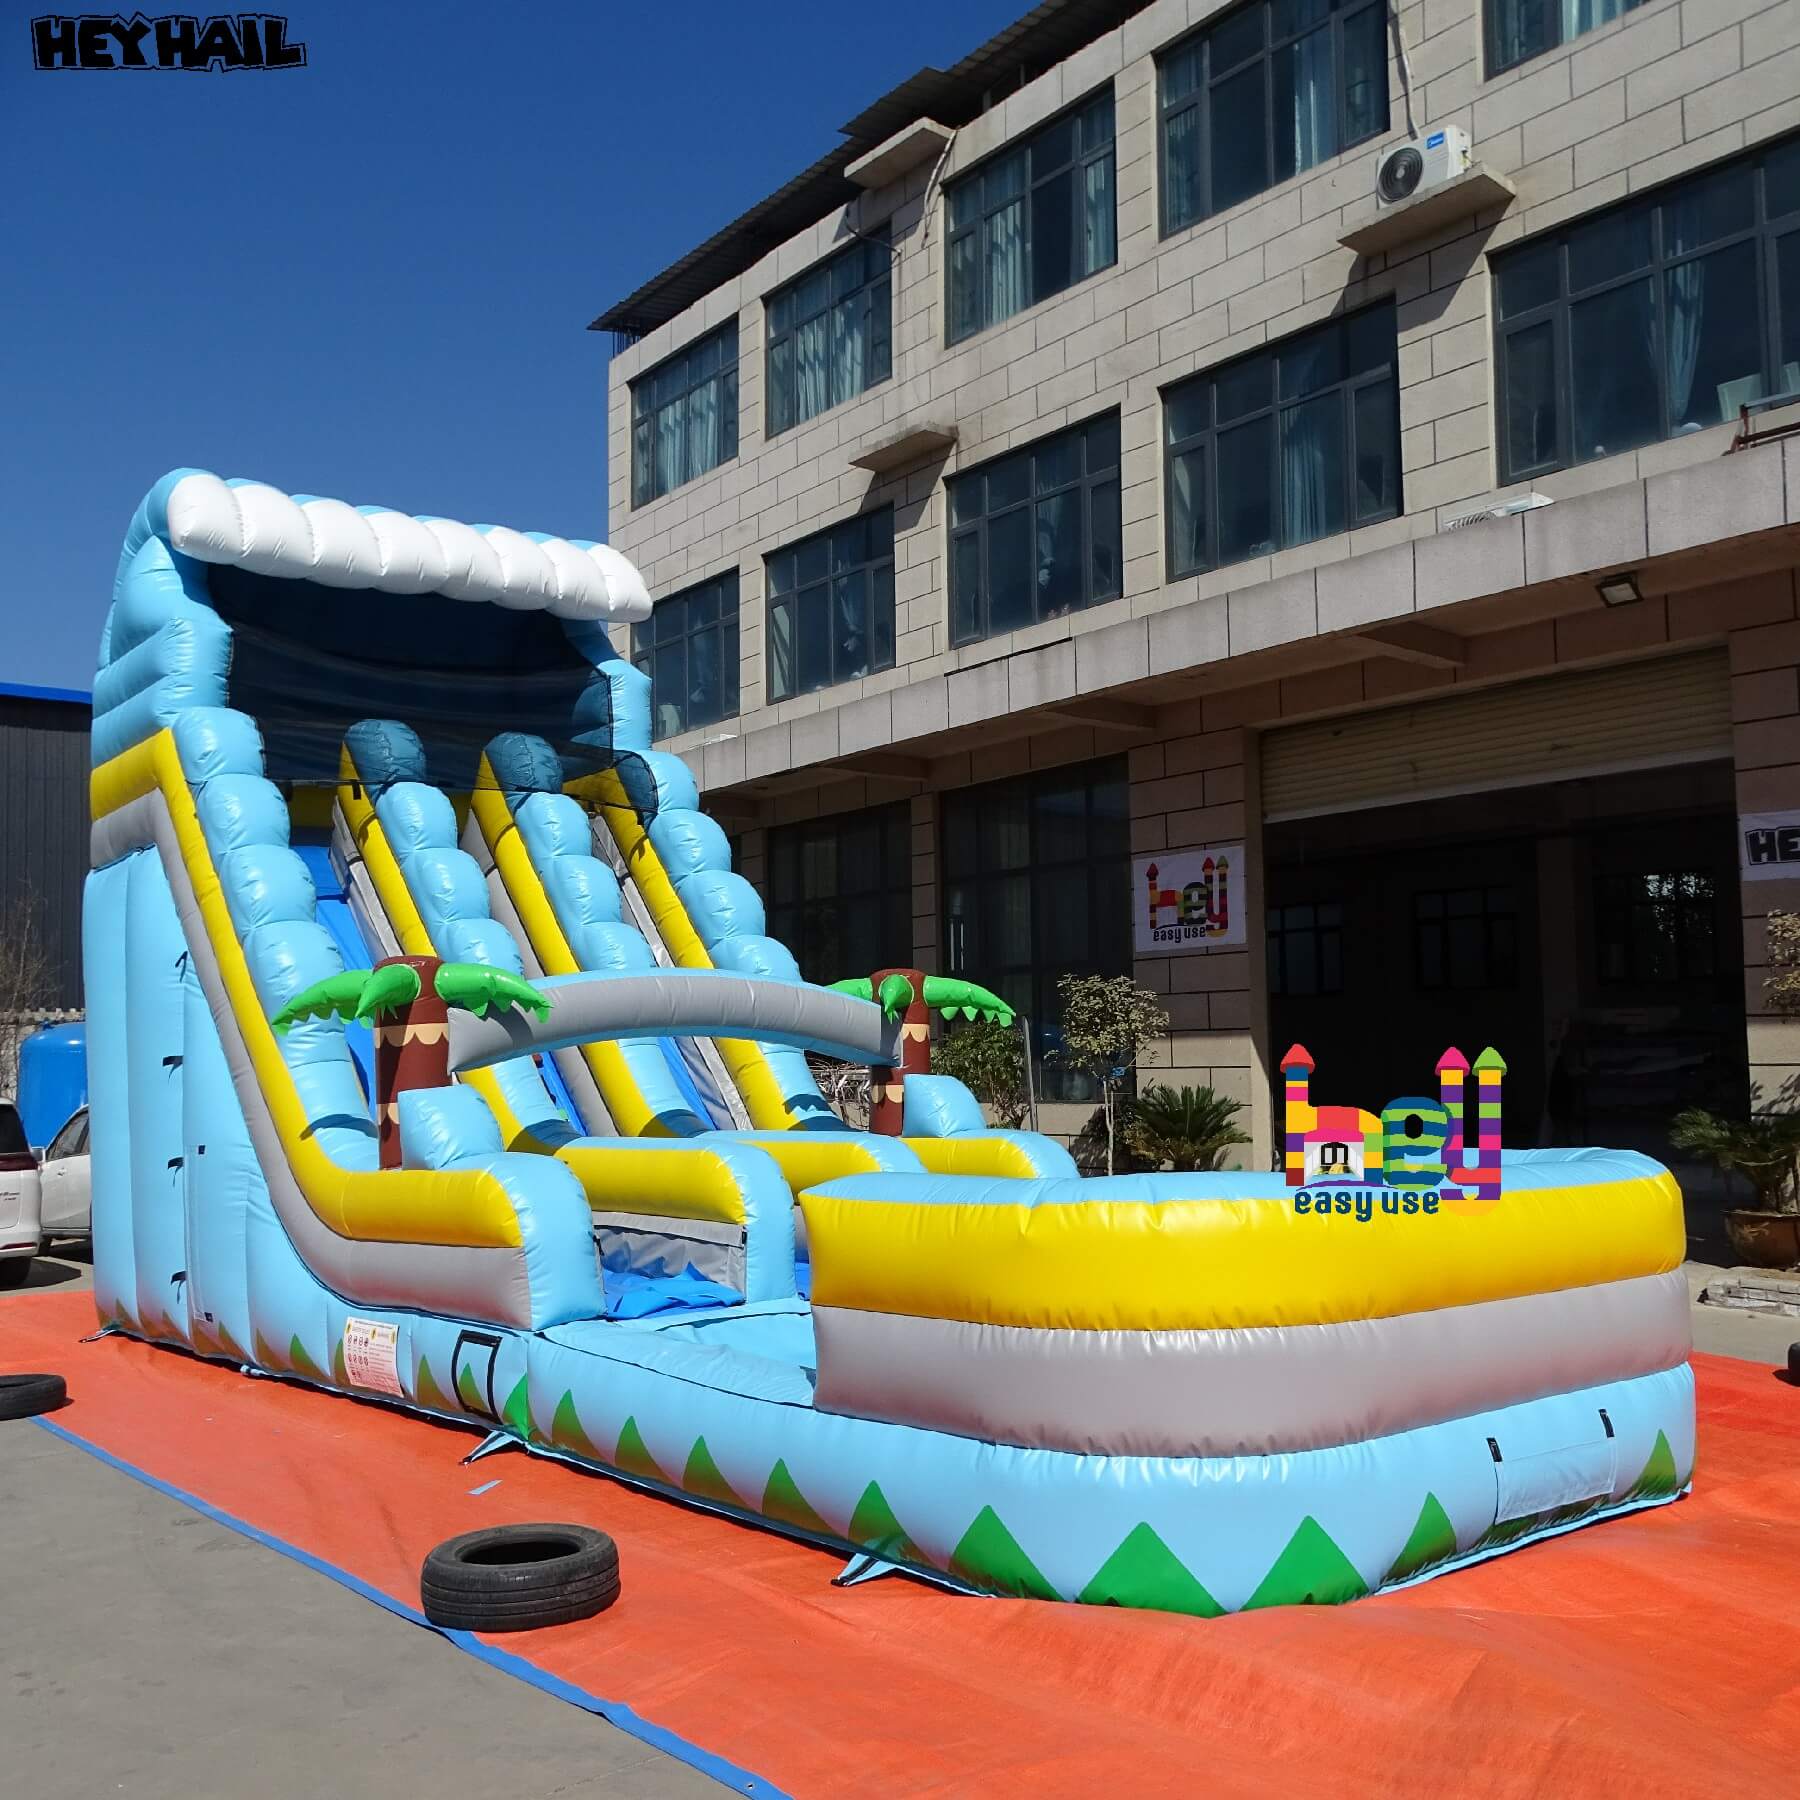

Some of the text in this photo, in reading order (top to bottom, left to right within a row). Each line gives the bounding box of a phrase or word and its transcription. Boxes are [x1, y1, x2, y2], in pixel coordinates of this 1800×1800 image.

[1146, 855, 1229, 938] hey
[1153, 926, 1206, 943] easy use
